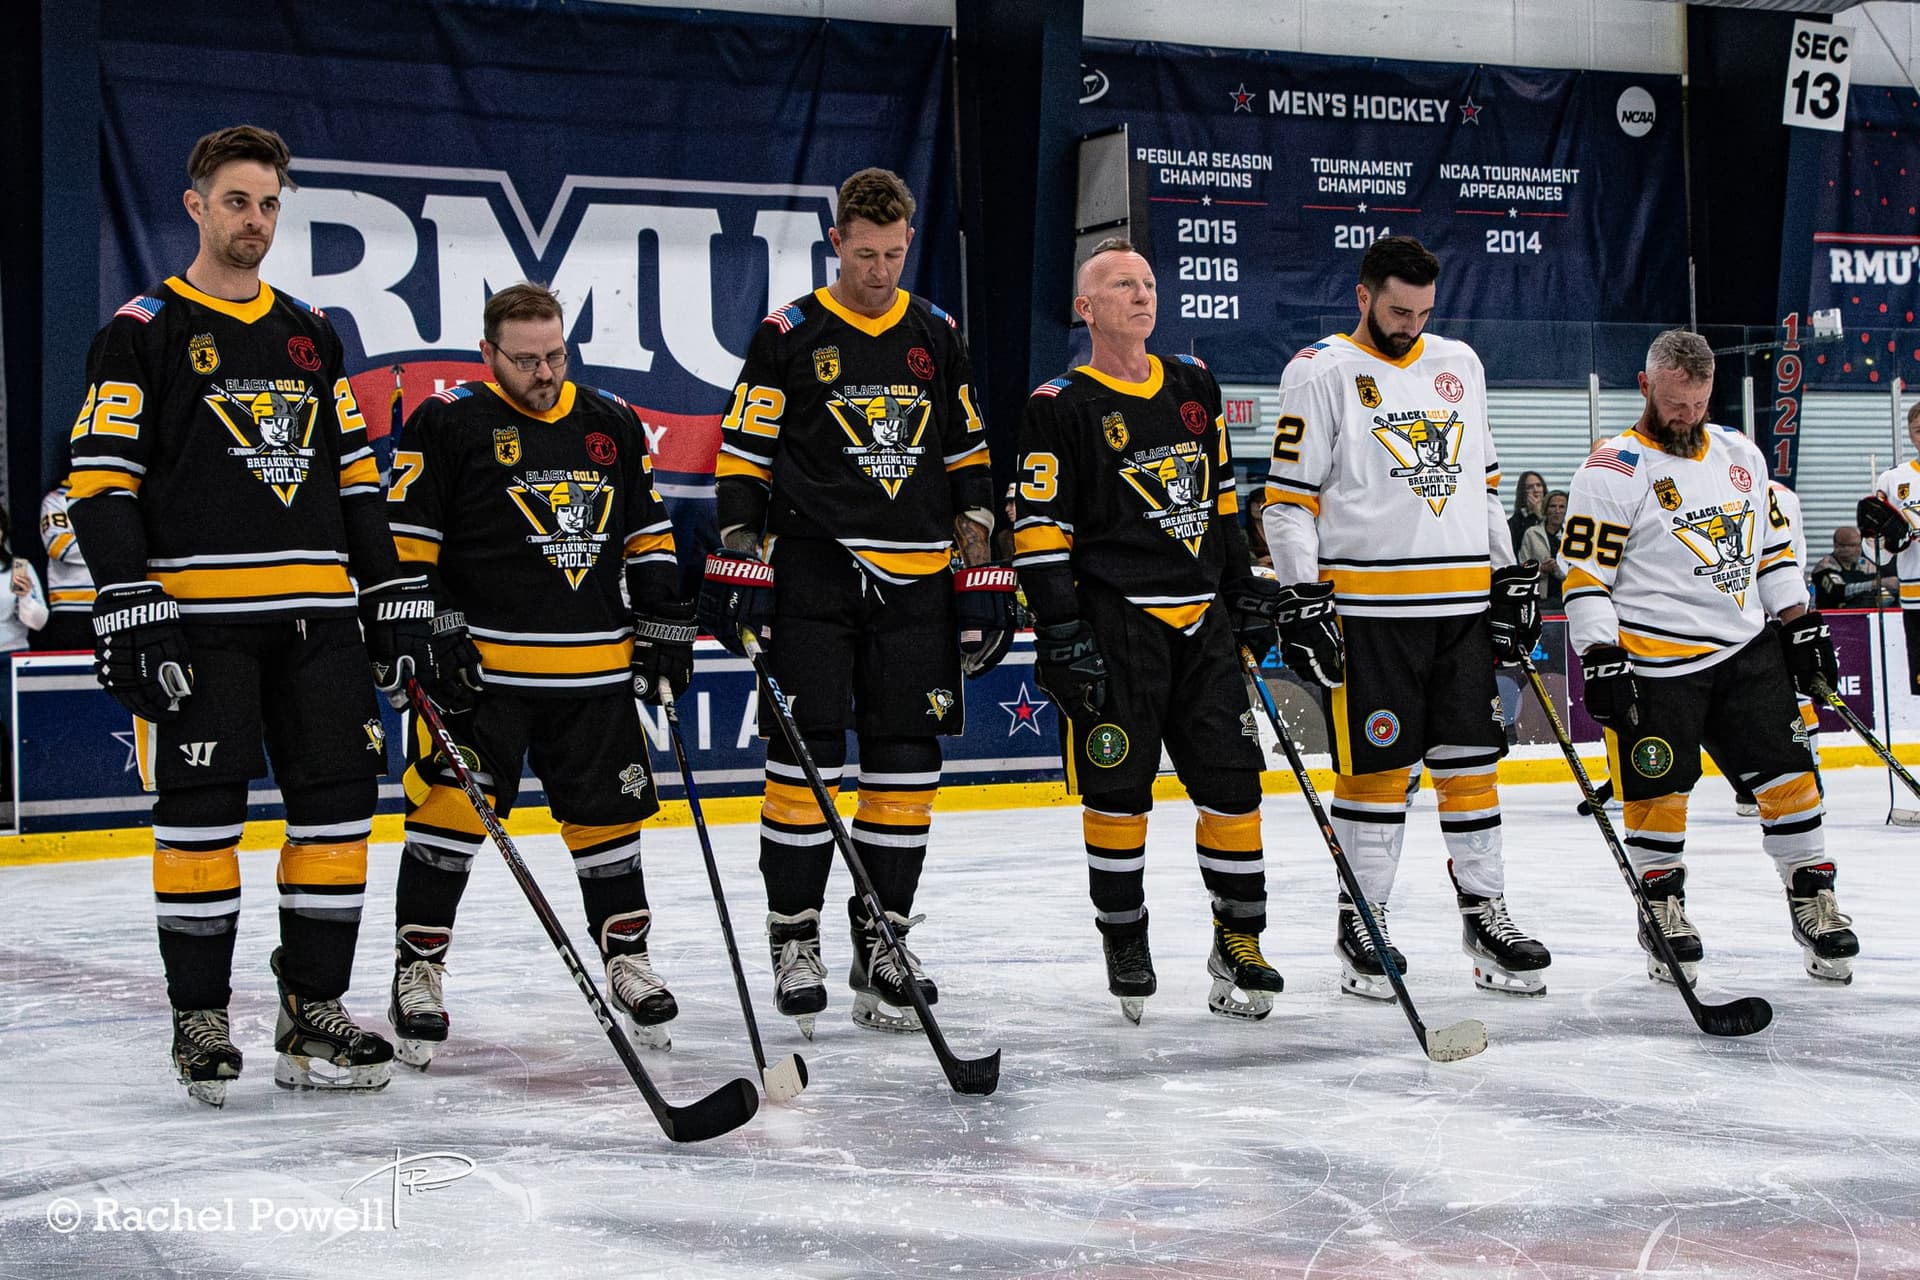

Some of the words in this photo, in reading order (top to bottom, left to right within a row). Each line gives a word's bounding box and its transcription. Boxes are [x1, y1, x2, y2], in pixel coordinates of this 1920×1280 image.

[1795, 31, 1848, 64] SEC
[1791, 70, 1841, 120] 13
[1268, 89, 1347, 118] MEN'S
[1353, 94, 1450, 124] HOCKEY
[1621, 110, 1656, 125] NCAA
[1136, 148, 1208, 167] REGULAR
[1212, 152, 1272, 171] SEASON
[1310, 157, 1413, 178] TOURNAMENT
[1160, 168, 1252, 188] CHAMPIONS
[1439, 164, 1480, 181] NCAA
[1483, 165, 1580, 184] TOURNAMENT
[1318, 176, 1406, 195] CHAMPIONS
[1459, 182, 1563, 201] APPEARANCES
[1177, 218, 1237, 244] 2015
[1486, 230, 1542, 254] 2014
[1179, 256, 1239, 282] 2016
[1829, 247, 1920, 285] RMU'
[260, 187, 824, 393] RMU
[1180, 294, 1239, 319] 2021
[226, 379, 268, 391] BLACK
[275, 379, 305, 391] GOLD
[844, 385, 884, 396] BLACK
[890, 384, 918, 396] GOLD
[721, 382, 786, 438] 12
[958, 384, 986, 433] 1
[1226, 400, 1253, 424] EXIT
[1387, 411, 1421, 422] BLACK
[1271, 413, 1307, 464] 2
[858, 455, 901, 465] BREAKING
[902, 456, 917, 465] THE
[1134, 445, 1170, 462] BLACK
[1175, 441, 1198, 455] GOLD
[246, 458, 294, 468] BREAKING
[294, 458, 309, 469] THE
[871, 465, 908, 478] MOLD
[262, 469, 303, 483] MOLD
[386, 451, 424, 502] 7
[526, 470, 566, 482] BLACK
[573, 470, 600, 481] GOLD
[1017, 452, 1059, 502] 3
[1408, 475, 1444, 486] BREAKING
[1445, 475, 1458, 483] THE
[1421, 484, 1451, 498] MOLD
[1686, 507, 1718, 522] BLACK
[1723, 501, 1743, 513] GOLD
[1768, 486, 1791, 530] 8
[1160, 513, 1197, 528] BREAKING
[1174, 523, 1205, 539] MOLD
[542, 543, 588, 555] BREAKING
[588, 543, 602, 553] THE
[1561, 514, 1632, 569] 85
[557, 554, 593, 568] MOLD
[965, 570, 1017, 587] WAR
[1712, 571, 1741, 584] BREAKING
[1725, 577, 1747, 594] MOLD
[92, 600, 180, 637] WARRIOR
[1583, 661, 1636, 681] CCM
[767, 676, 793, 720] CCM
[437, 728, 469, 771] CCM
[459, 781, 513, 863] JETSPEED
